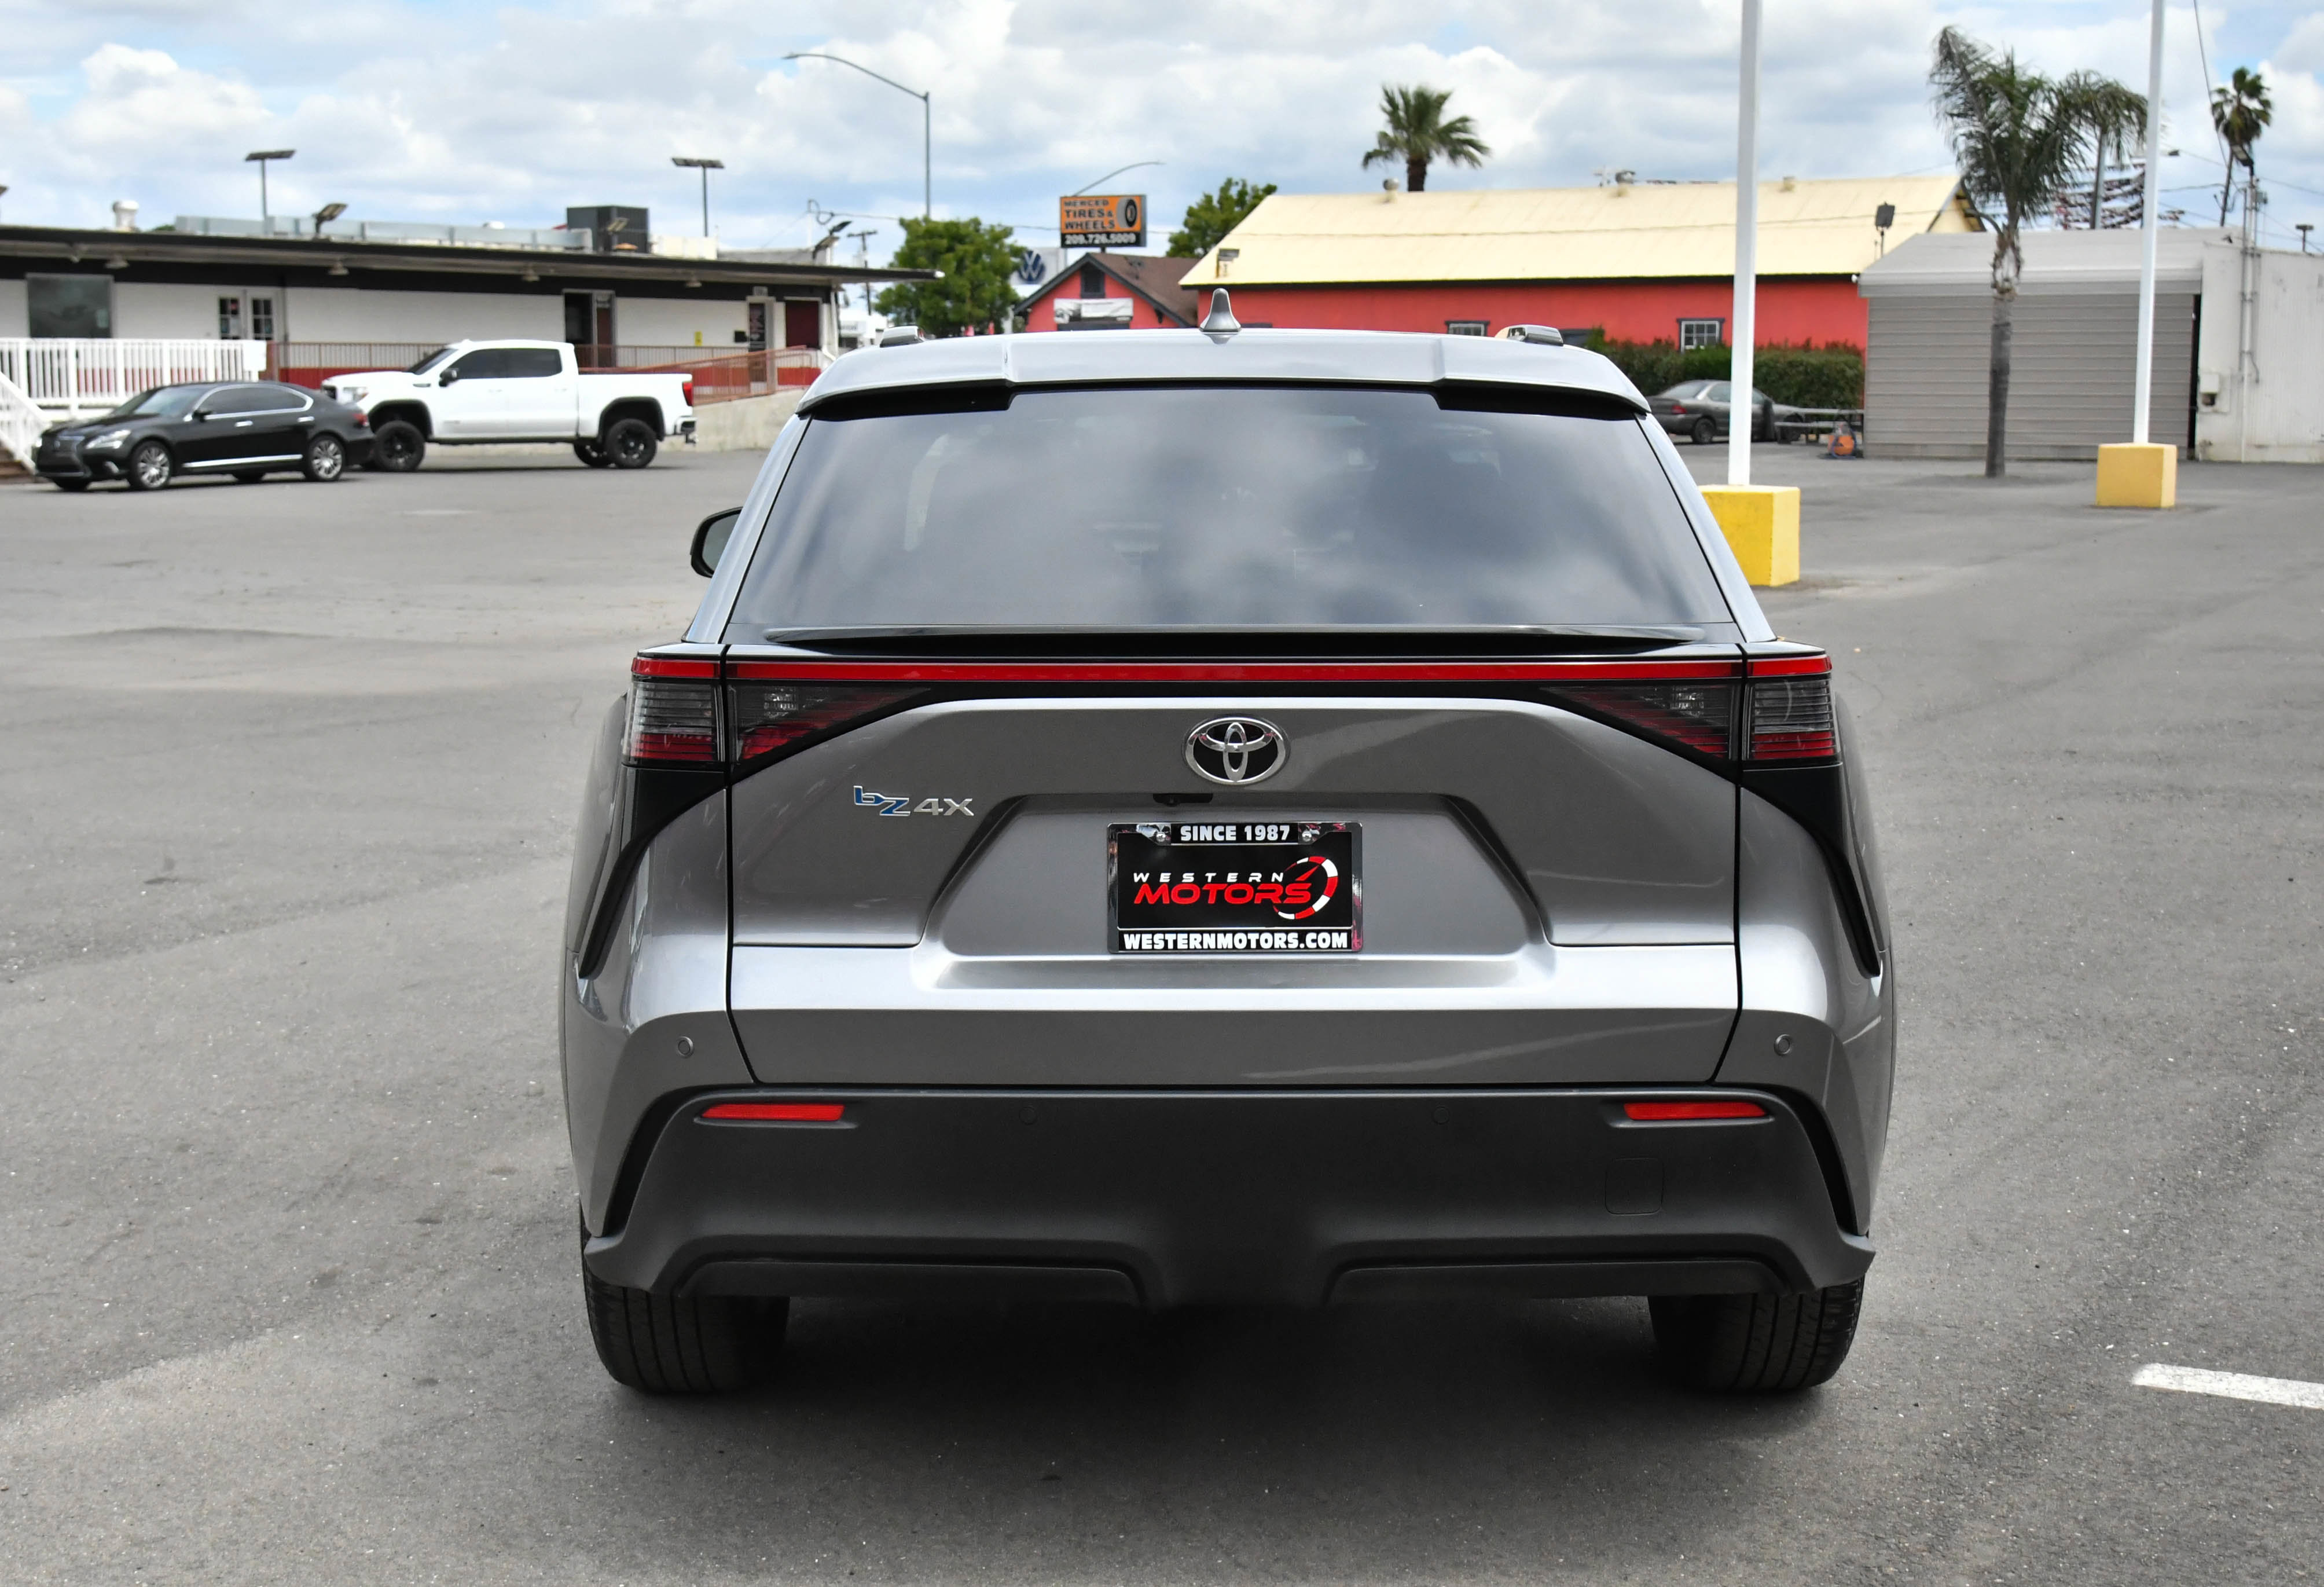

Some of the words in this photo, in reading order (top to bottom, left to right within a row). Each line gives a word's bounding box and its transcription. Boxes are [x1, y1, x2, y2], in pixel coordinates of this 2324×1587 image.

[1065, 209, 1106, 218] TIRES
[1065, 219, 1115, 230] WHEELS
[1180, 825, 1237, 841] SINCE
[1244, 824, 1290, 841] 1987
[1133, 873, 1284, 882] WESTERN
[1133, 883, 1312, 904] MOTORS
[1124, 932, 1348, 950] WESTERNMOTORS.COM
